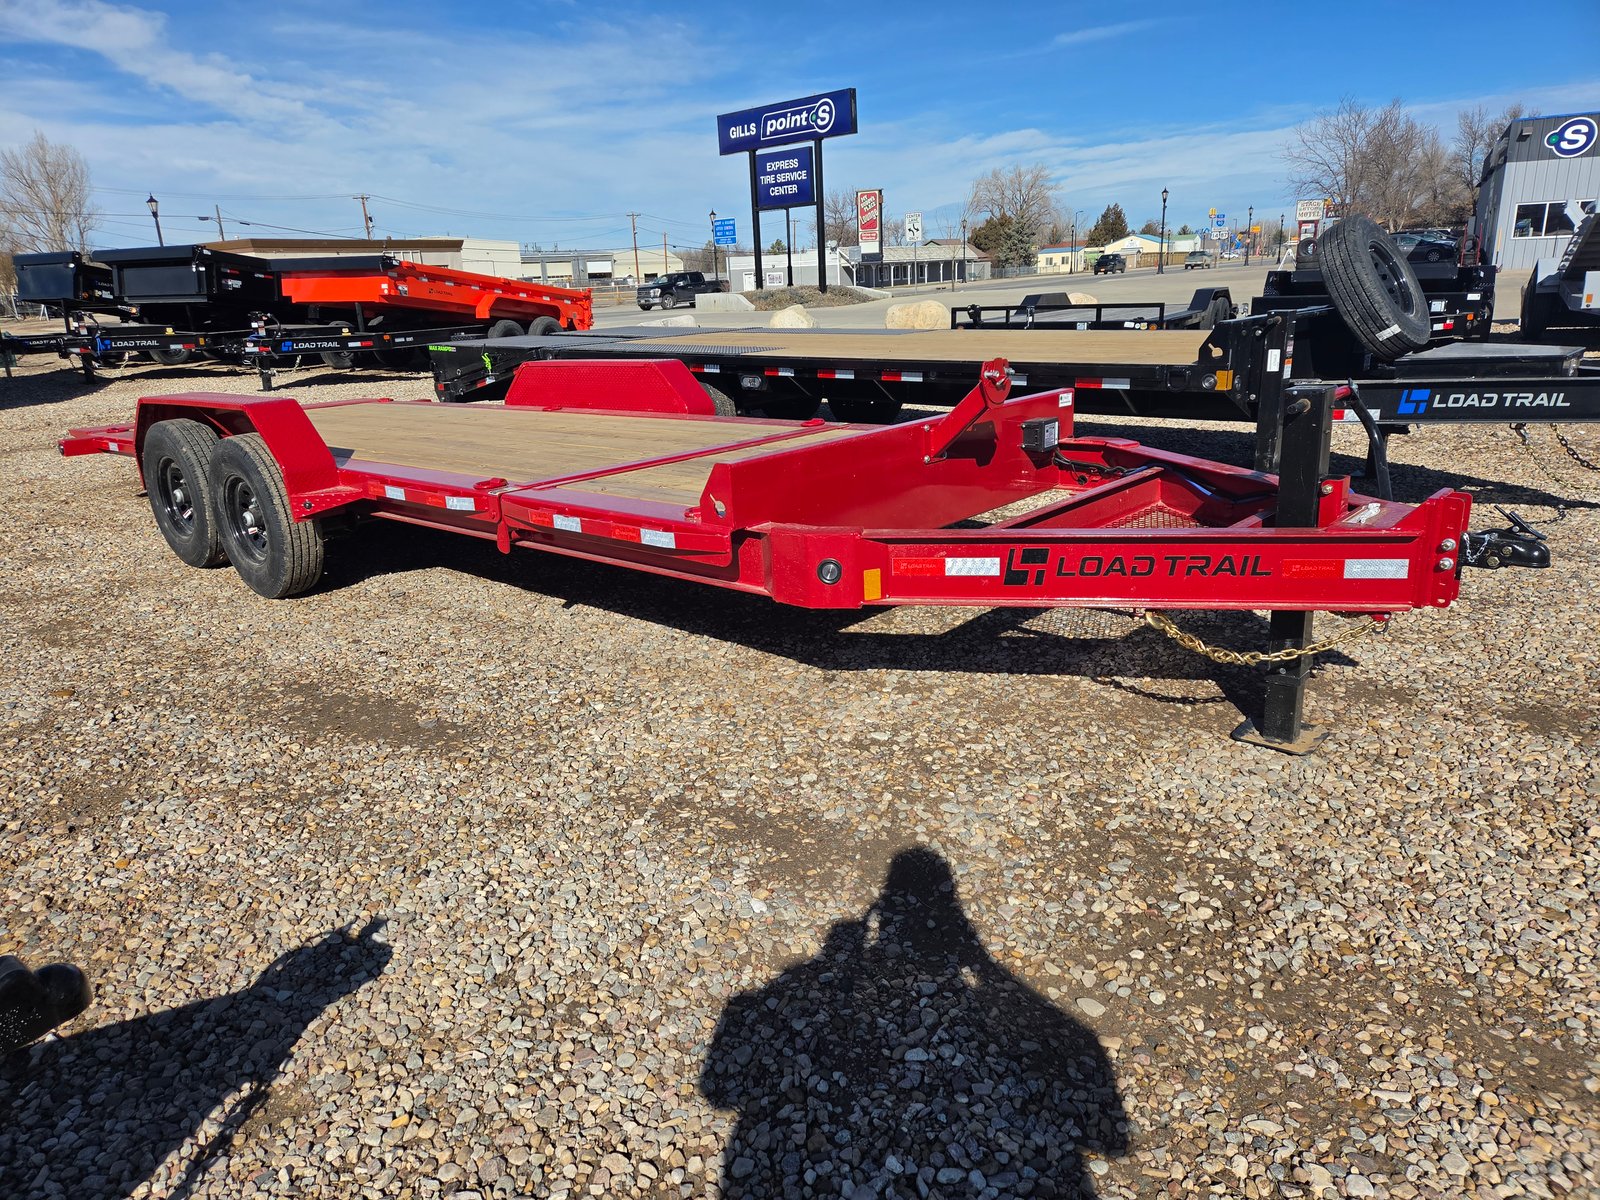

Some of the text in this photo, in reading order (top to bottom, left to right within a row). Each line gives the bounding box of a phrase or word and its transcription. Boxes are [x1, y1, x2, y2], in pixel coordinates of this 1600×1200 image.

[729, 105, 830, 139] GILLS point S
[1560, 124, 1589, 150] S
[766, 158, 798, 172] EXPRESS
[760, 170, 807, 185] TIRE SERVICE
[769, 185, 798, 196] CENTER
[1432, 393, 1498, 408] LOAD
[1503, 393, 1570, 407] TRAIL
[1056, 556, 1155, 577] LOAD
[1164, 555, 1272, 576] TRAIL
